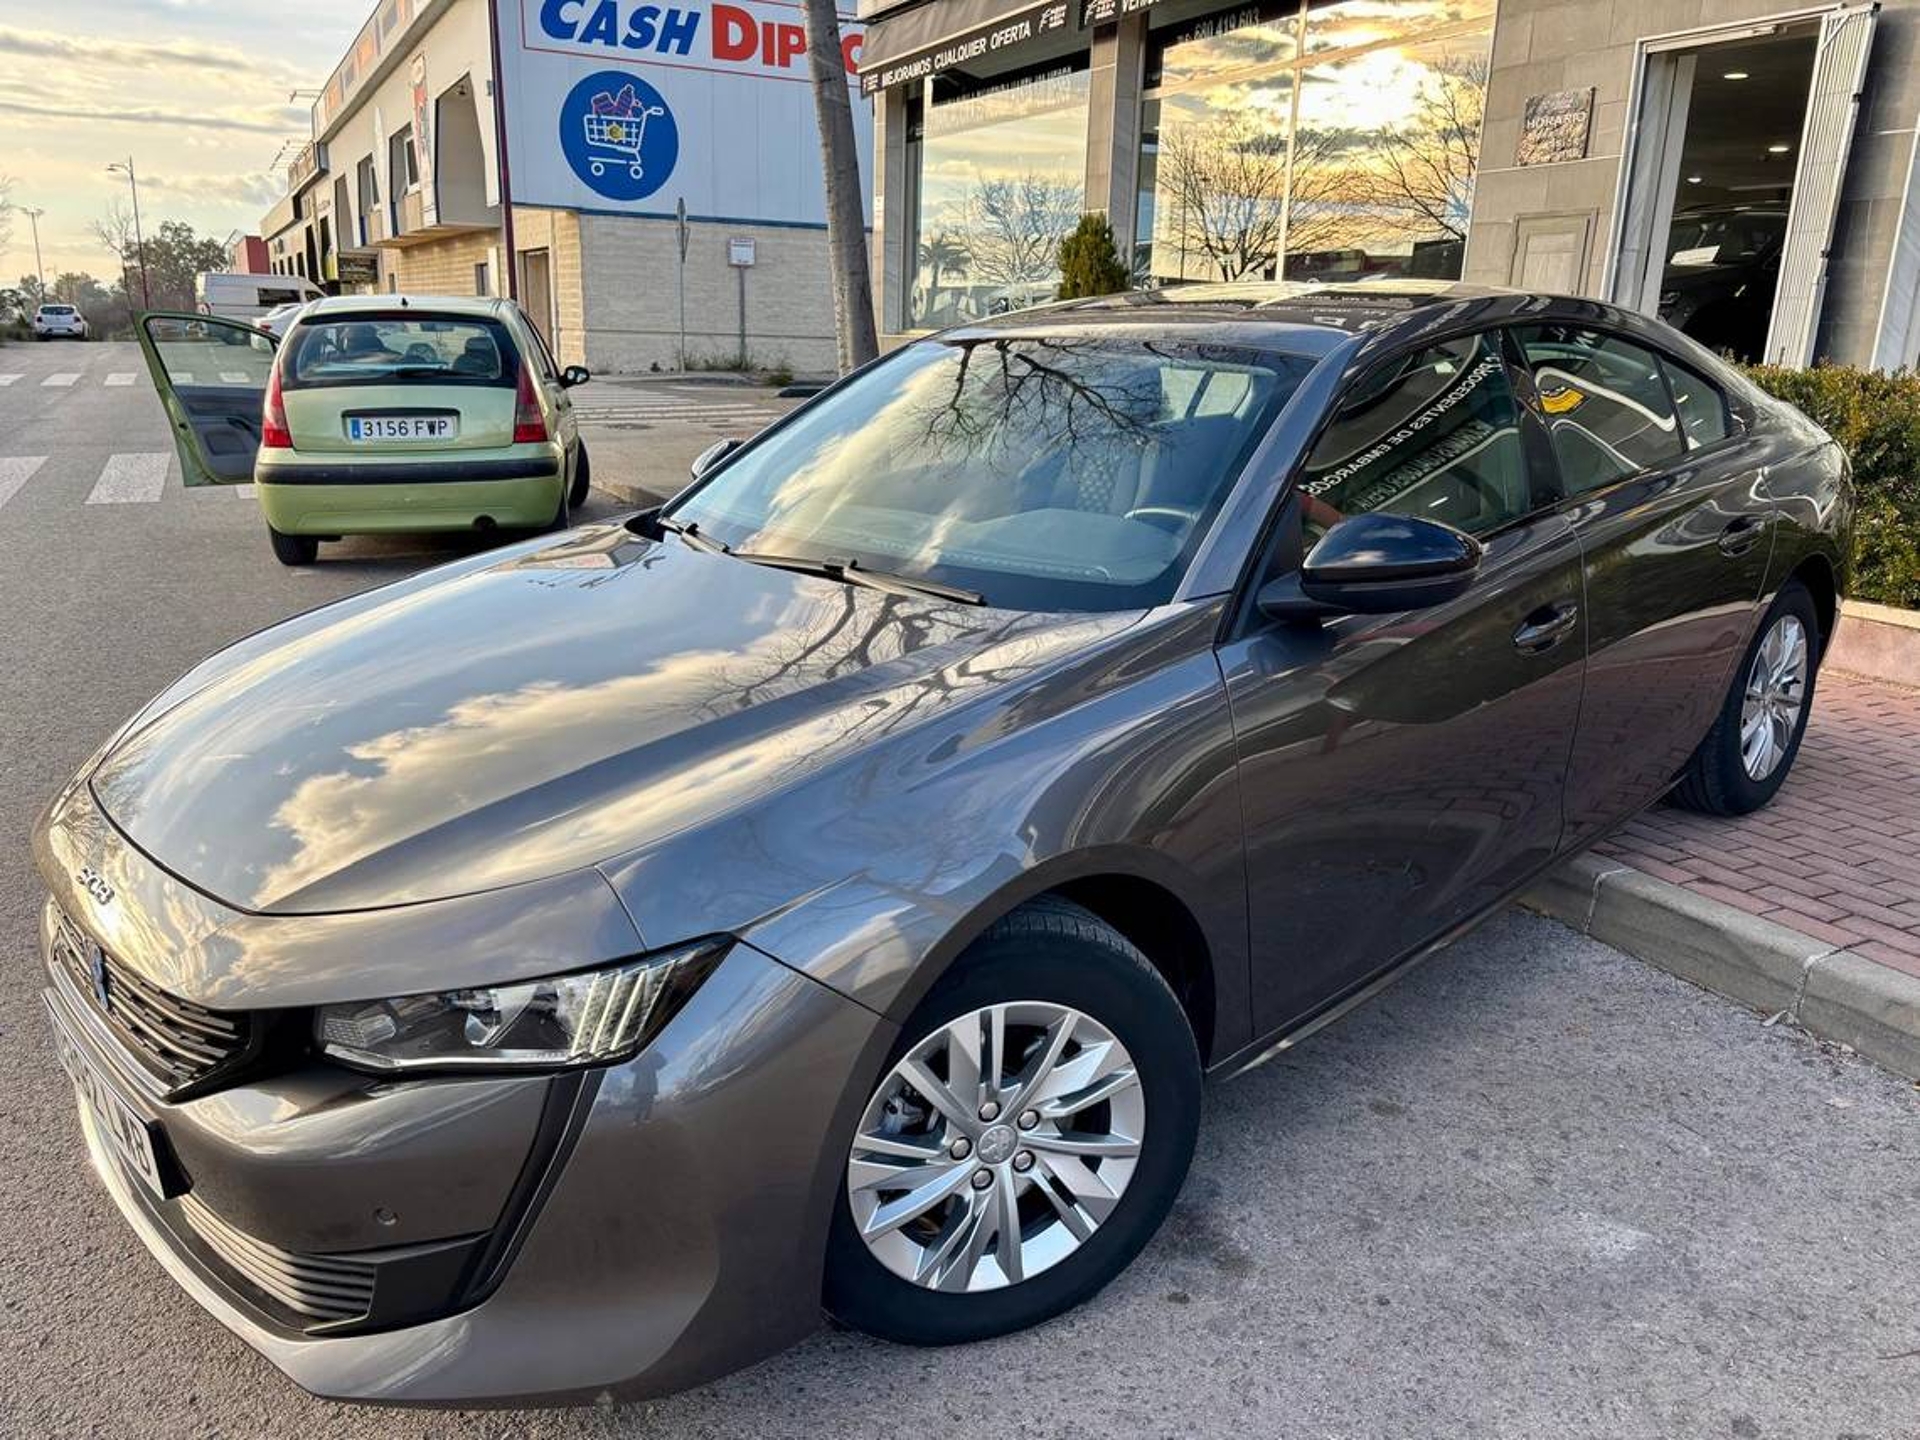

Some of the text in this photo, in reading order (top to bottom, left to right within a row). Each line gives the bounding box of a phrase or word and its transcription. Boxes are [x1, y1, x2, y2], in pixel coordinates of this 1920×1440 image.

[540, 0, 701, 56] CASH
[882, 57, 931, 88] MEJORAMOS
[934, 37, 986, 70] CUALQUIER
[990, 20, 1031, 50] OFERTA
[1526, 112, 1586, 129] HORARIO
[363, 420, 447, 436] 3156 FWP
